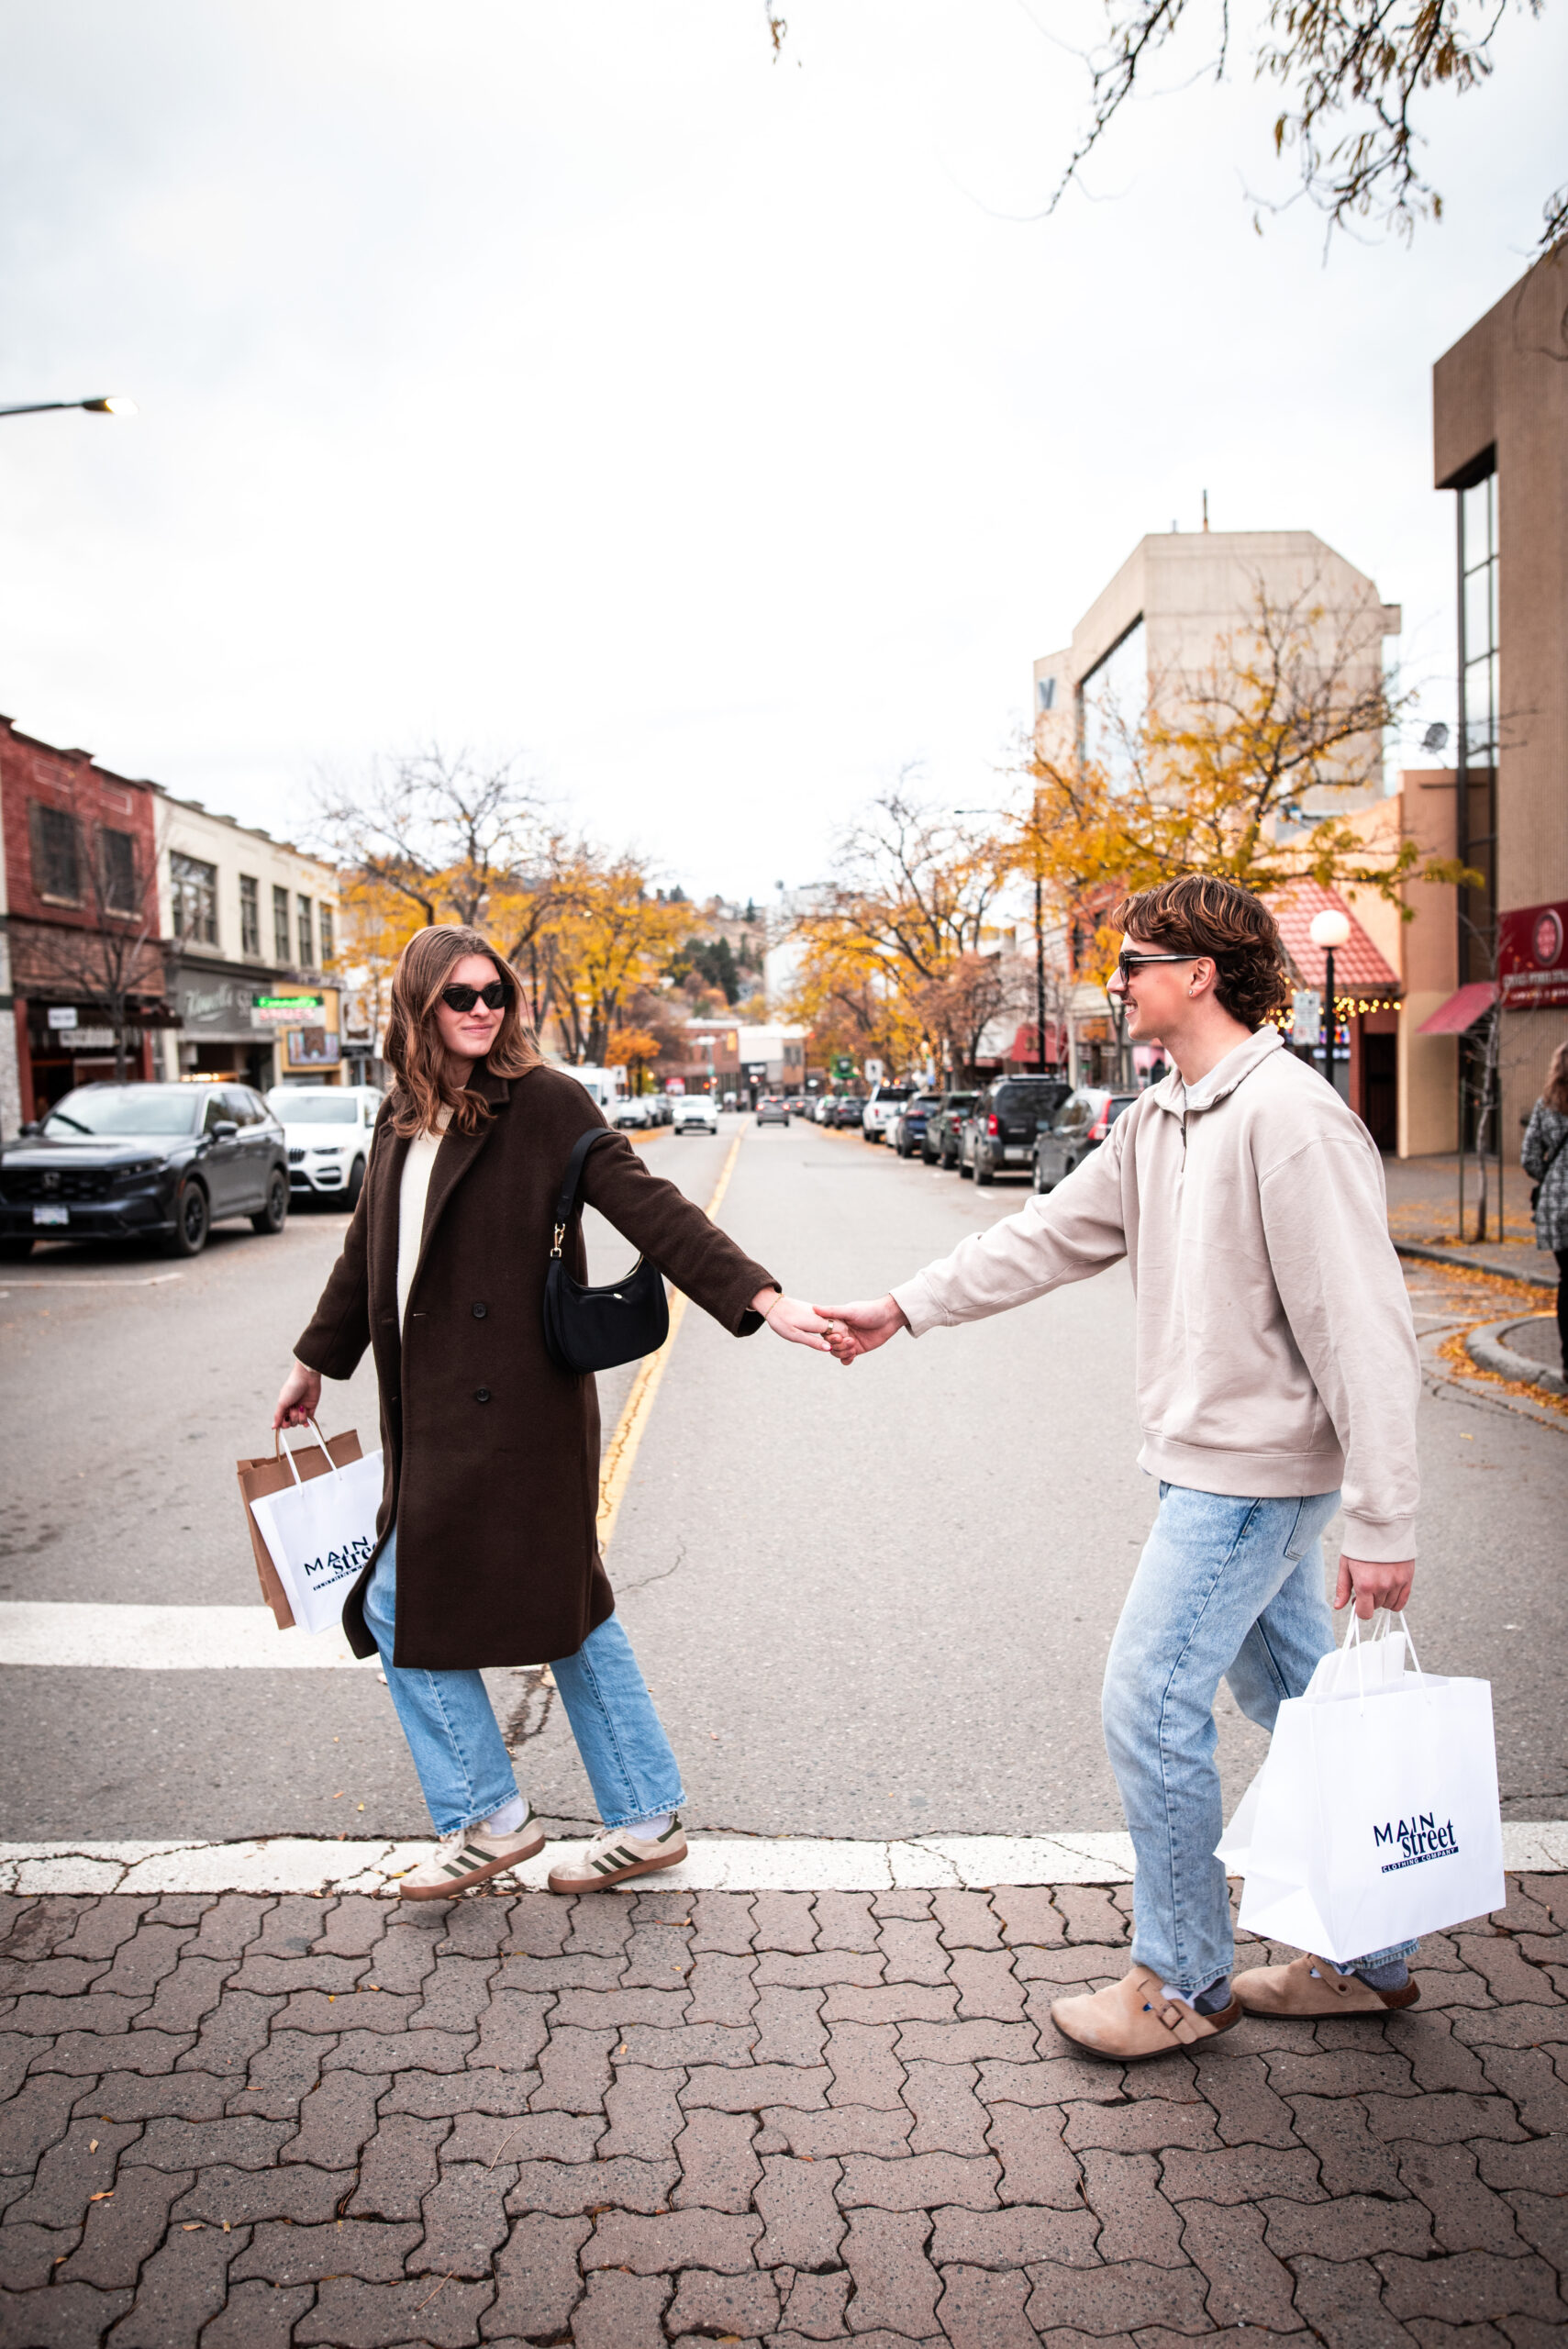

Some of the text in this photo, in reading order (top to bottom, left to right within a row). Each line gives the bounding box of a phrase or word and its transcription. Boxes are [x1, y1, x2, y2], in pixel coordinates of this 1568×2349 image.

[304, 1535, 369, 1576] MAIN
[1373, 1811, 1435, 1847] MAIN
[1401, 1818, 1457, 1859] street
[1382, 1848, 1455, 1873] CLOTHING COMPANY
